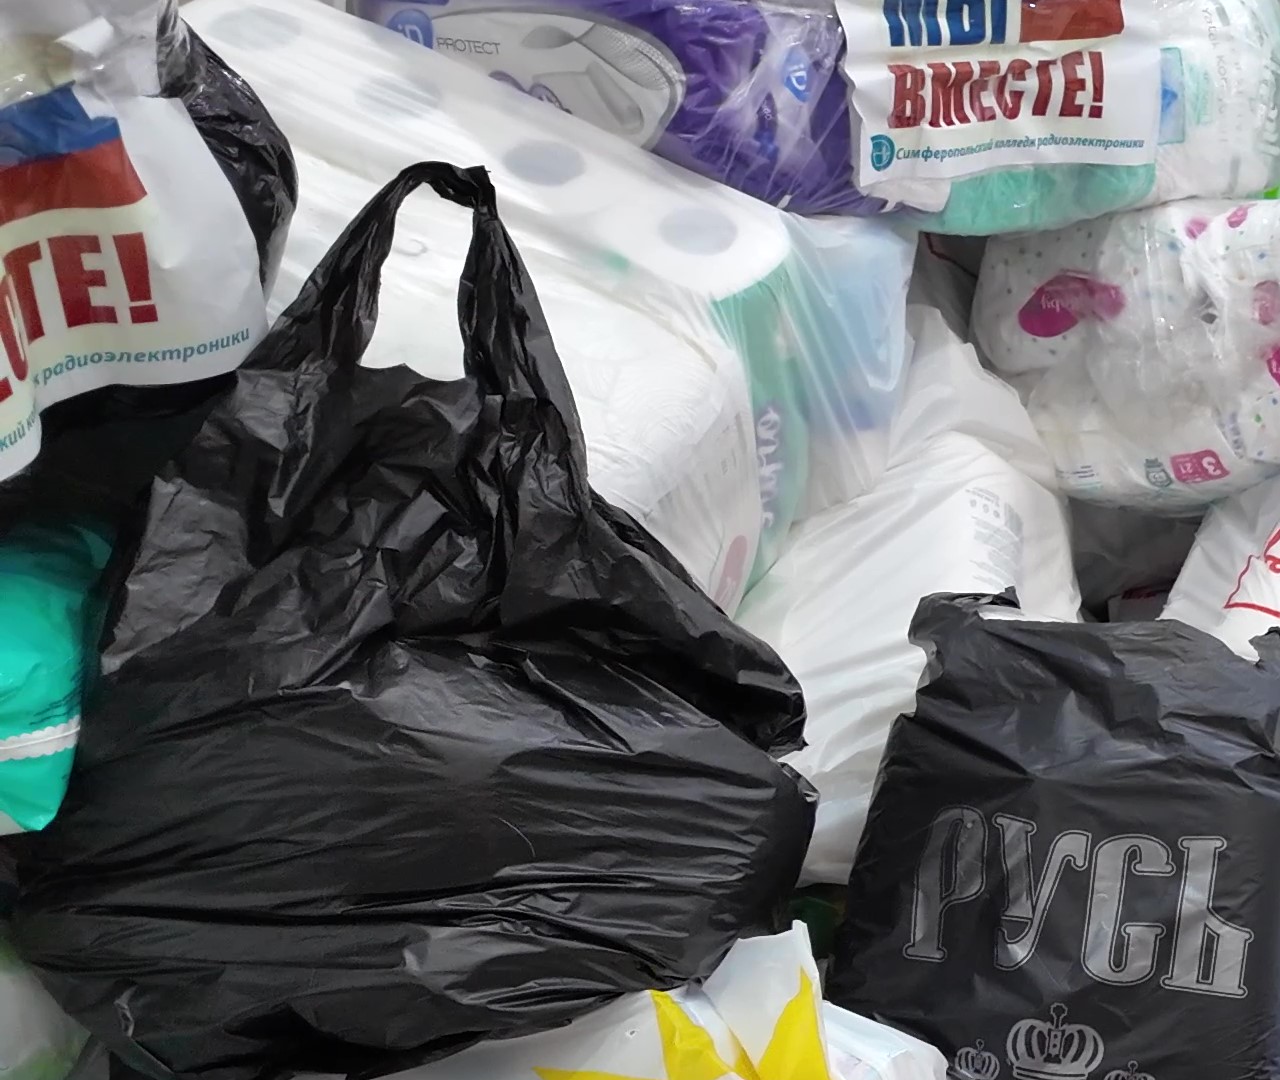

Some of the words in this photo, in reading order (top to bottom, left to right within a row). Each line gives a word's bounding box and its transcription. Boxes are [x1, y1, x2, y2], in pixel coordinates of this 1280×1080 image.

[436, 37, 502, 55] PROTECT
[887, 50, 1105, 129] ВМЕСТЕ!
[43, 327, 250, 385] радиоэлектроники
